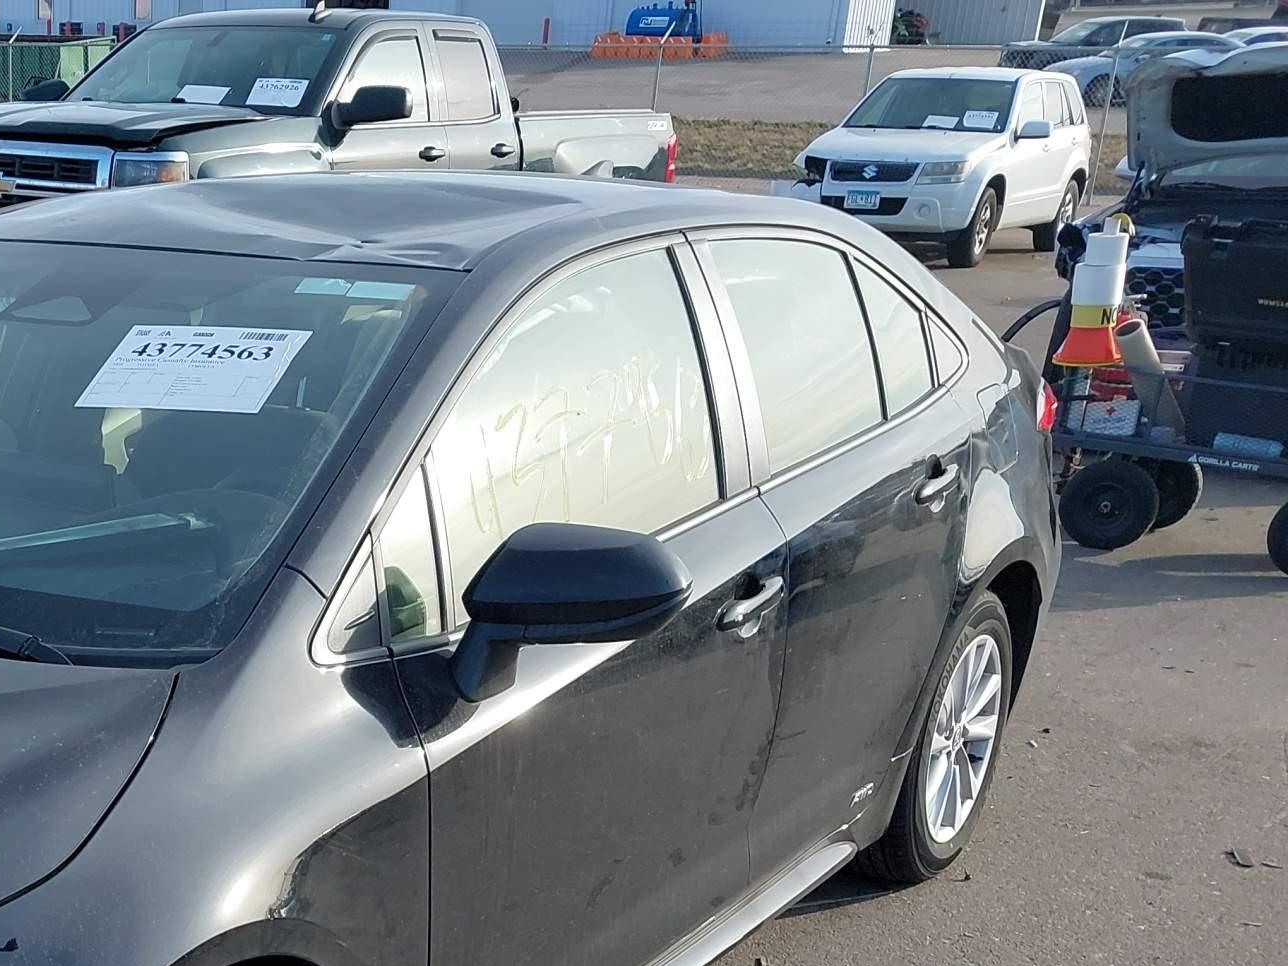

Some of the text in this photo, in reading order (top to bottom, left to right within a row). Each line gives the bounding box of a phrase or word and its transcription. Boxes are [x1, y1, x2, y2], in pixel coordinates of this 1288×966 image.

[131, 342, 274, 361] 43774563
[1198, 456, 1229, 467] GORILLA
[929, 632, 970, 722] YOKOHAMA
